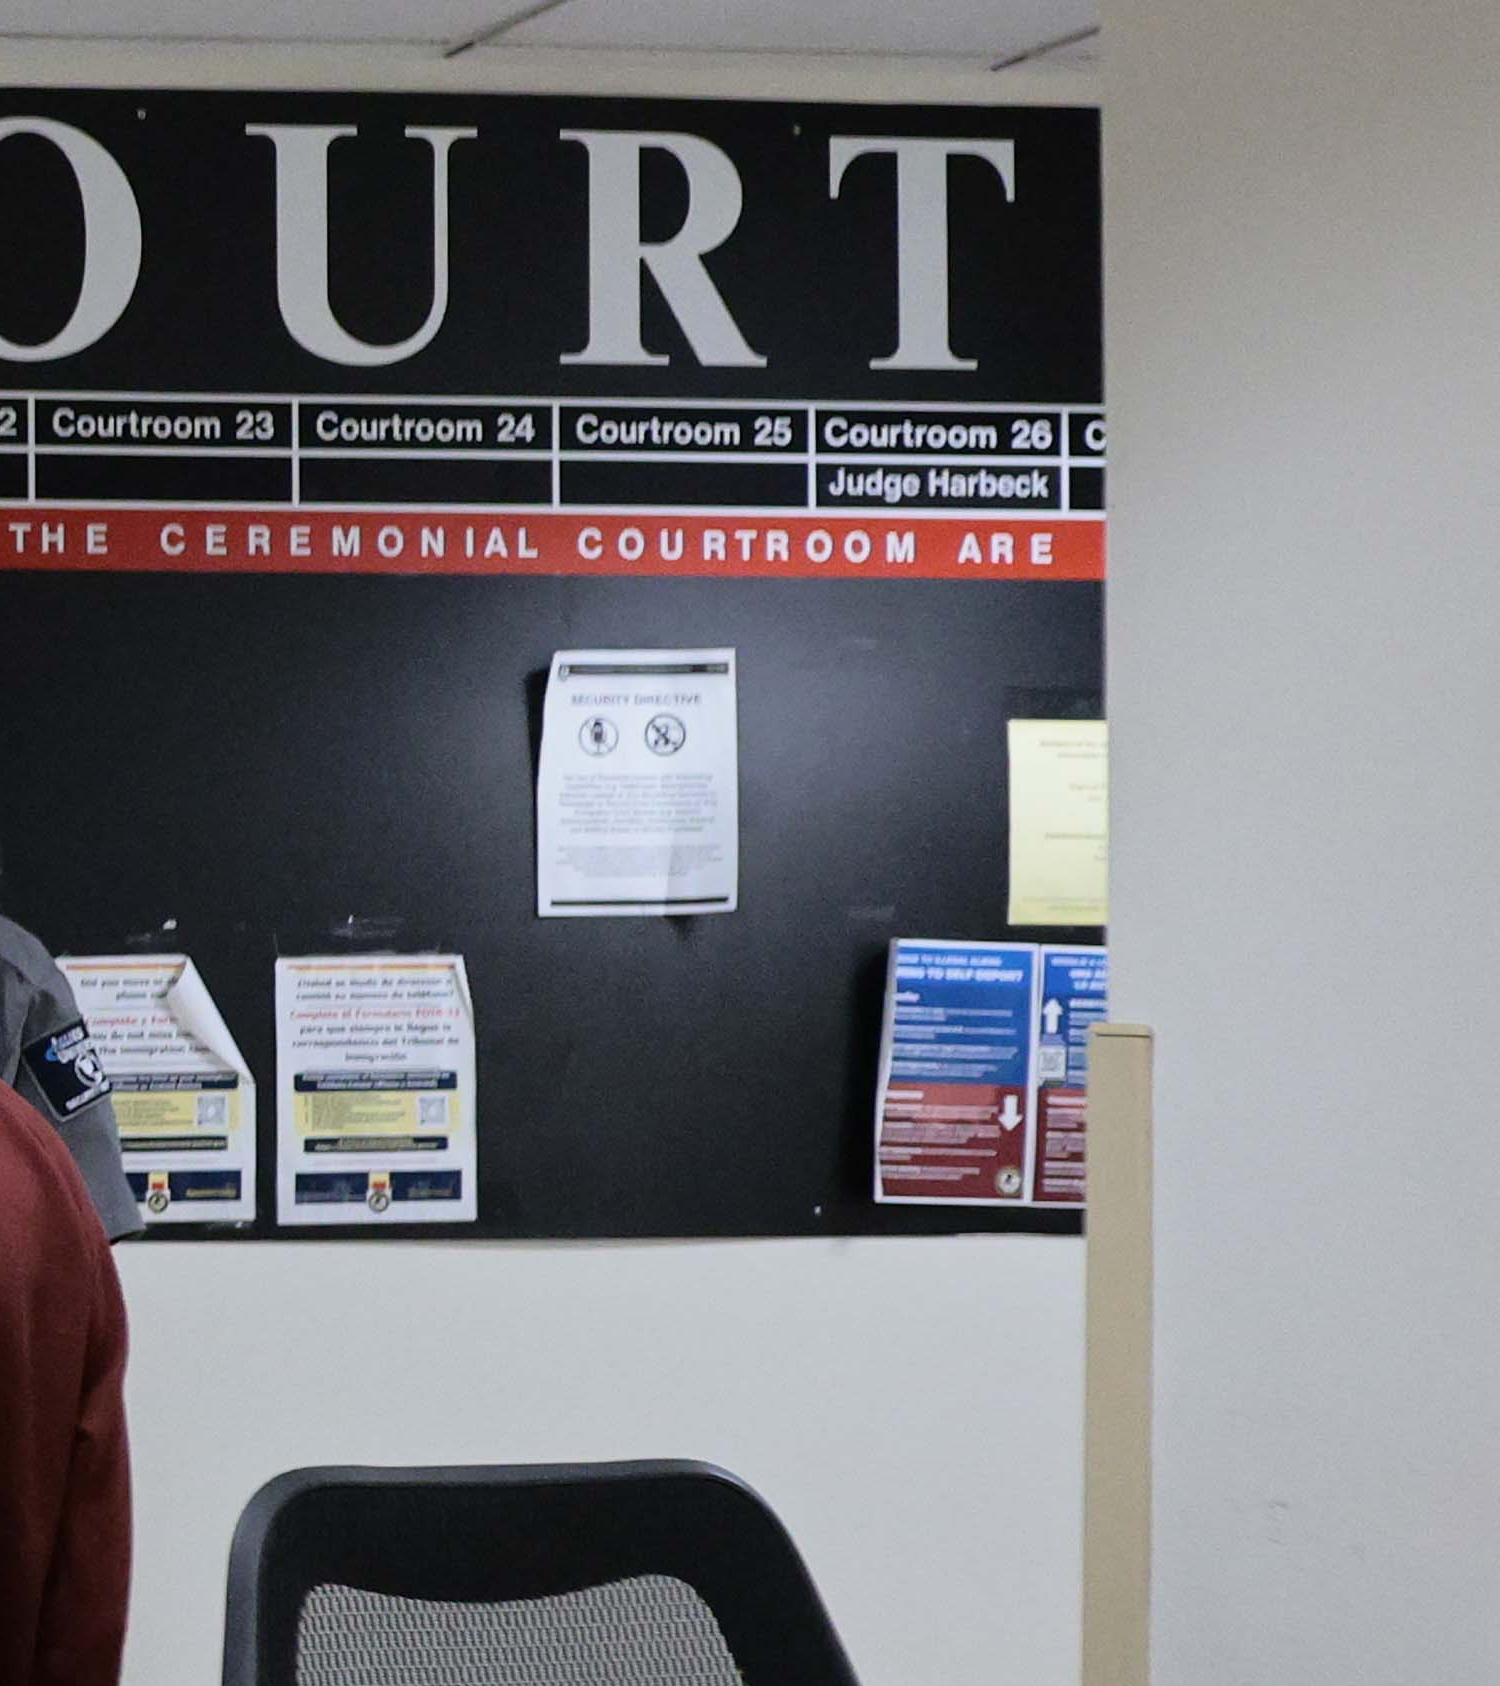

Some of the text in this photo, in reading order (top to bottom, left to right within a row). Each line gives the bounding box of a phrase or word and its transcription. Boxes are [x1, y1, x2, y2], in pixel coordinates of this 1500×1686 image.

[52, 407, 274, 440] Courtroom 23
[316, 411, 535, 443] Courtroom 24
[576, 413, 792, 446] Courtroom 25
[825, 417, 997, 450] Courtroom
[1011, 421, 1052, 450] 26
[829, 467, 1048, 503] Judge Harbeck
[8, 522, 108, 554] THE
[161, 523, 539, 559] CEREMONIAL
[577, 527, 915, 564] COURTROOM
[957, 532, 1053, 565] ARE
